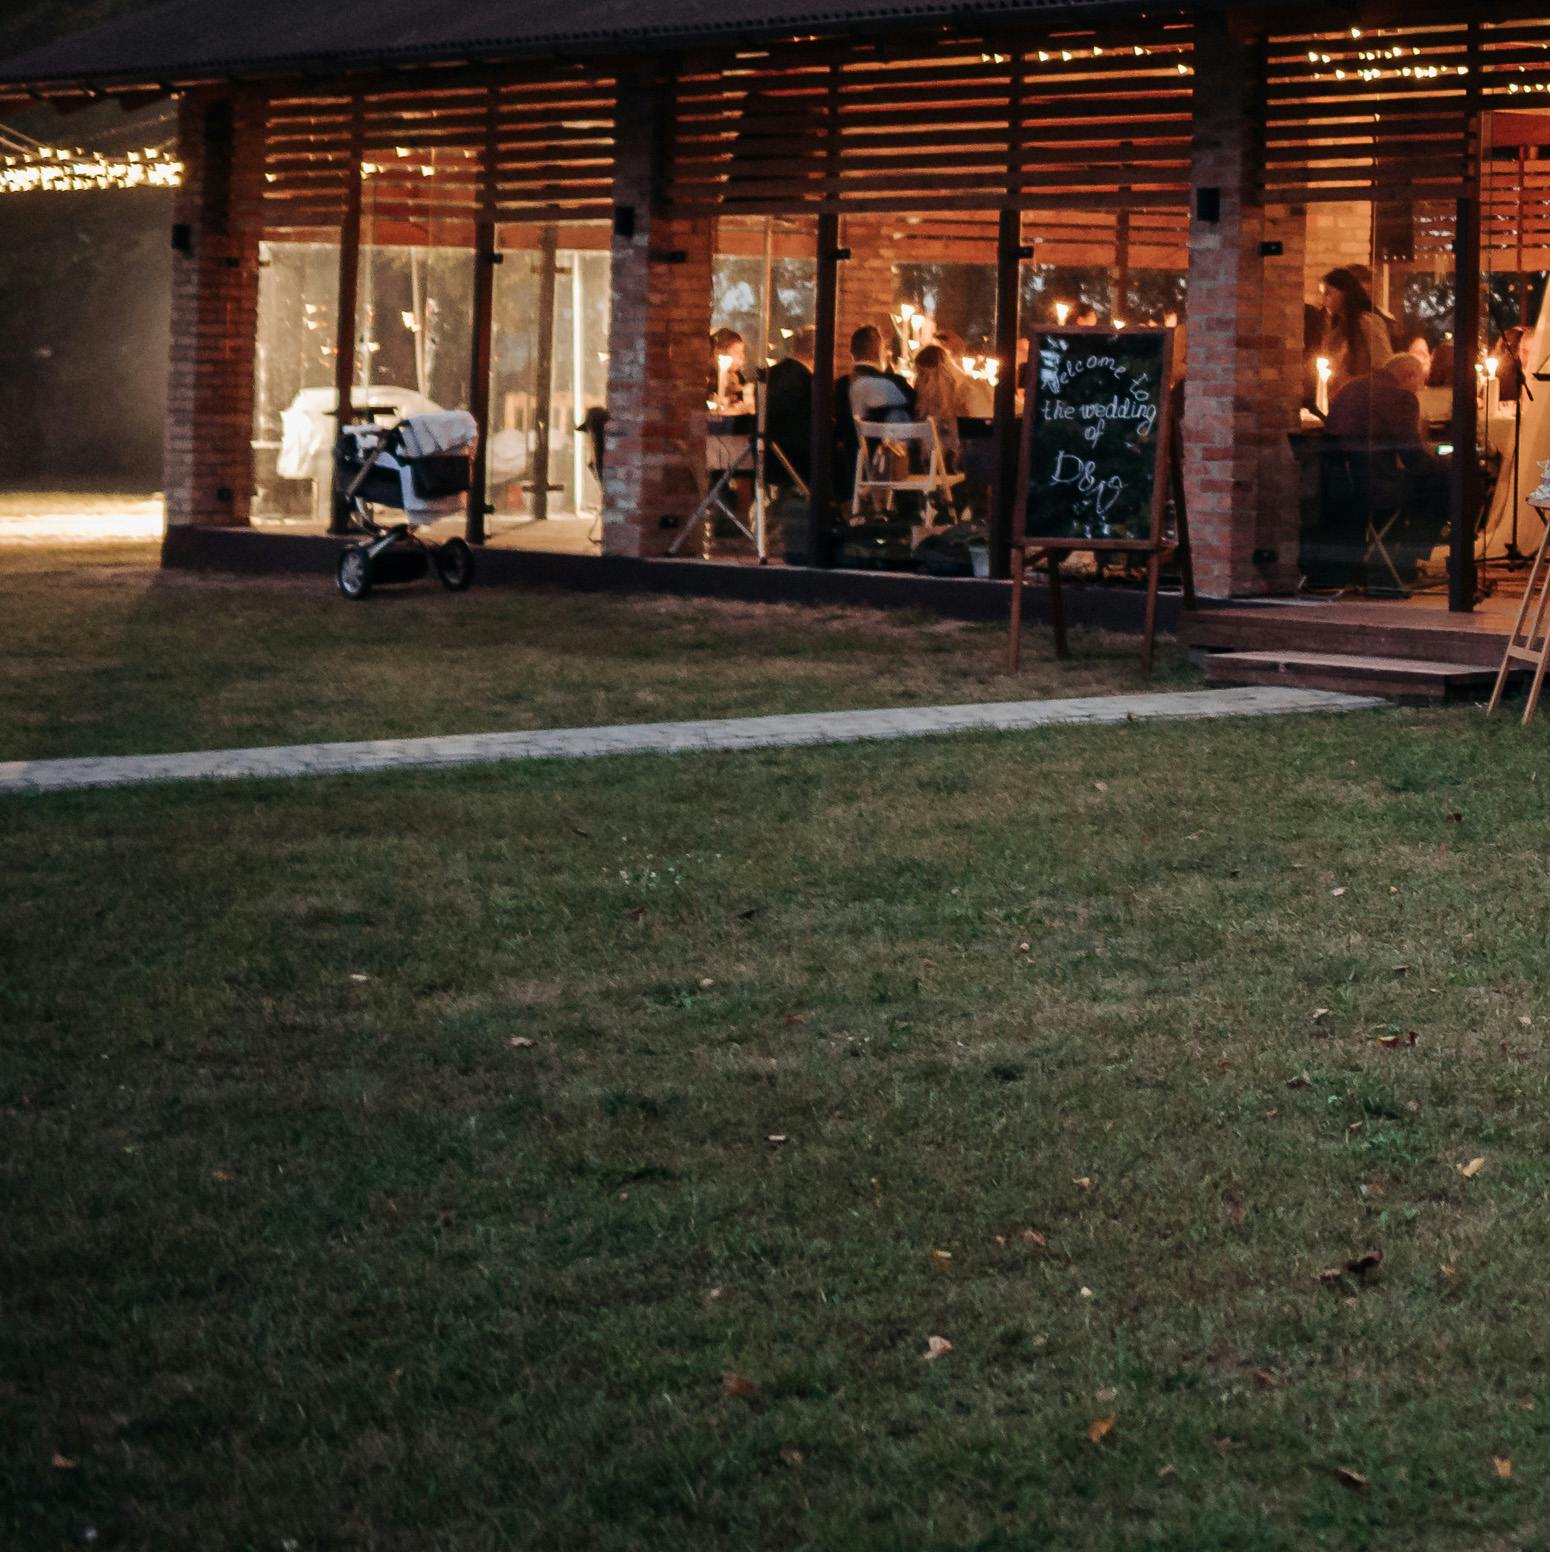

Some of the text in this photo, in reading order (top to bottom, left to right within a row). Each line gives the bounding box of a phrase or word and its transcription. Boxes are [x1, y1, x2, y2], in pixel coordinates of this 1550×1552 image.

[1130, 372, 1150, 401] to
[1041, 394, 1157, 437] the wedding
[1084, 418, 1105, 448] of
